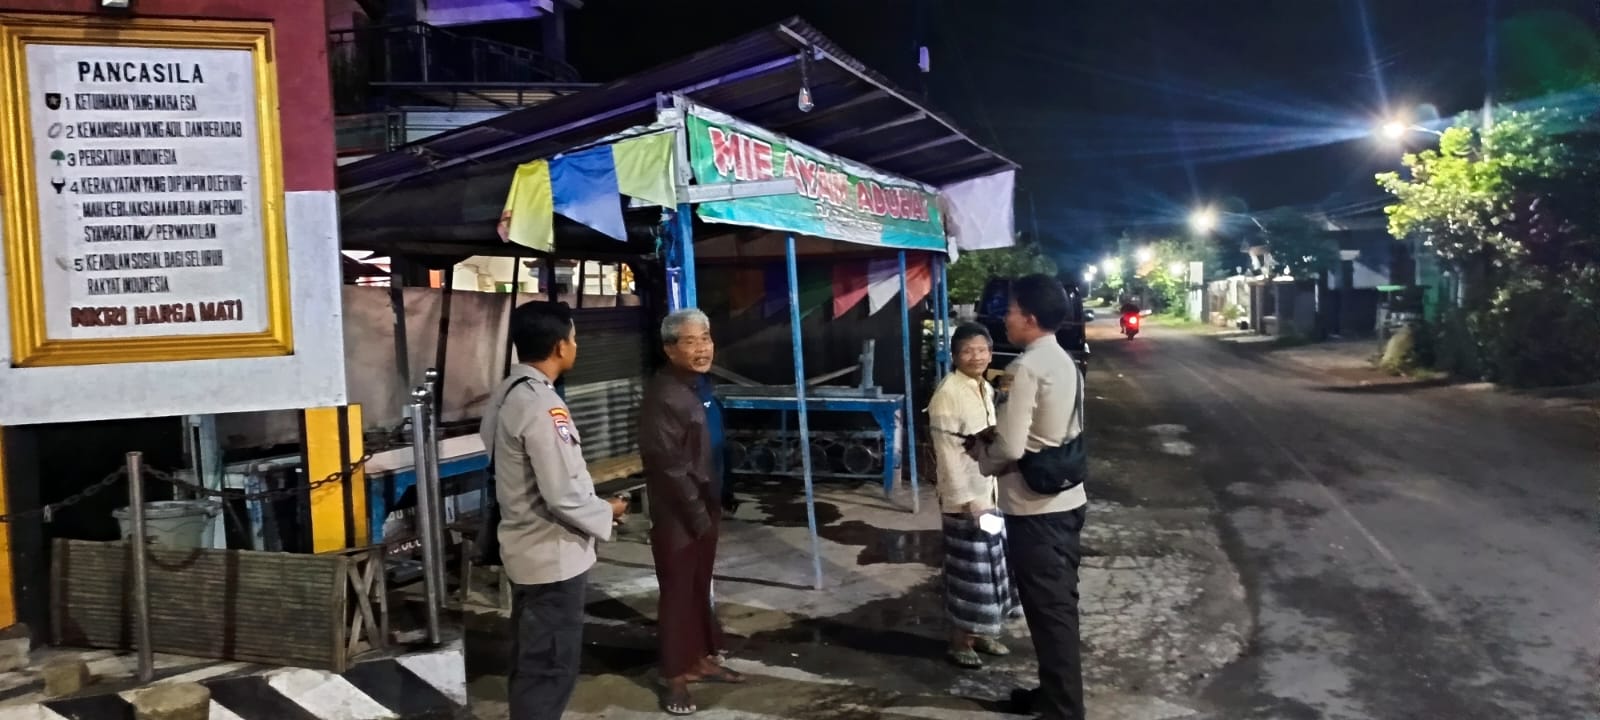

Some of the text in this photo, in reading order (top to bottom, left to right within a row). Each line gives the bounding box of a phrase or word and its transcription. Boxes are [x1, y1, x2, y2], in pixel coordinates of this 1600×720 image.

[78, 61, 204, 84] PANCASILA
[130, 94, 153, 110] YANG
[180, 94, 197, 110] ESA
[65, 121, 242, 138] 2 KEMANUSIAAN YANG ADIL DAN BERADAB
[67, 149, 177, 166] 3 PERSATUAN INDONESIA
[708, 126, 773, 181] MIE
[70, 181, 78, 194] 4
[81, 176, 140, 194] KERAKYATAN
[142, 176, 165, 193] YANG
[167, 175, 205, 192] DIPIMPIN
[207, 175, 229, 192] OLEH
[83, 201, 102, 217] MAH
[104, 200, 178, 217] KEBIJAKSANAAN
[180, 200, 211, 216] DALAM
[74, 249, 223, 272] 5 KEADILAN SOSIAL BAGI SELURUH
[88, 276, 169, 295] RAKYAT INDONESIA
[71, 299, 243, 327] NKRI HARGA MATI
